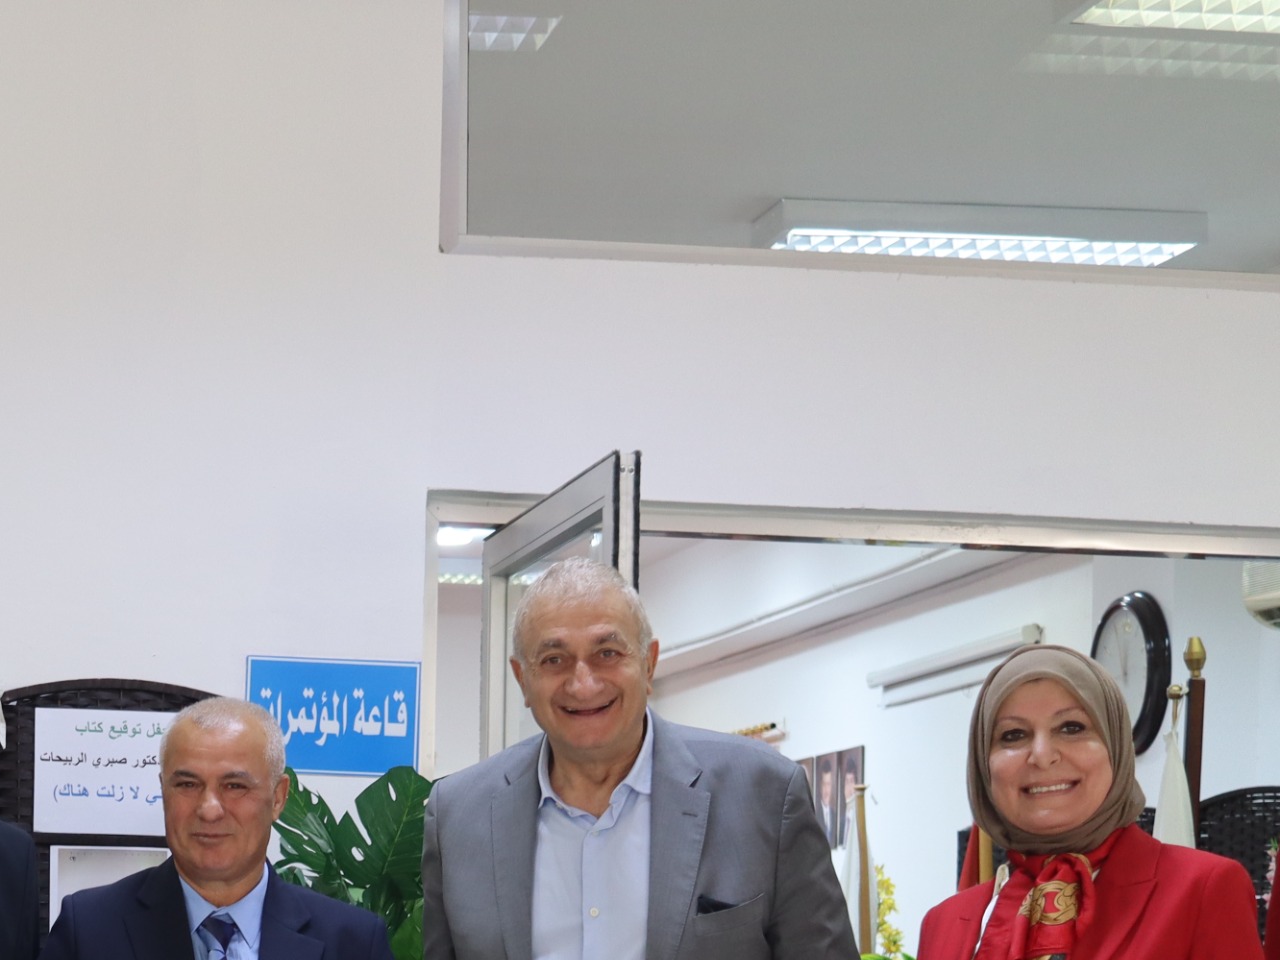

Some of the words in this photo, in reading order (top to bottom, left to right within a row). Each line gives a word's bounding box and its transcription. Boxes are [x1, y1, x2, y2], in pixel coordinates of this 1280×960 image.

[353, 687, 409, 737] قاعة
[75, 721, 104, 737] كتاب
[108, 720, 142, 740] توقيع
[39, 752, 87, 767] الربيحات
[92, 755, 128, 769] صبري
[96, 784, 125, 803] زلت
[129, 785, 140, 800] لا
